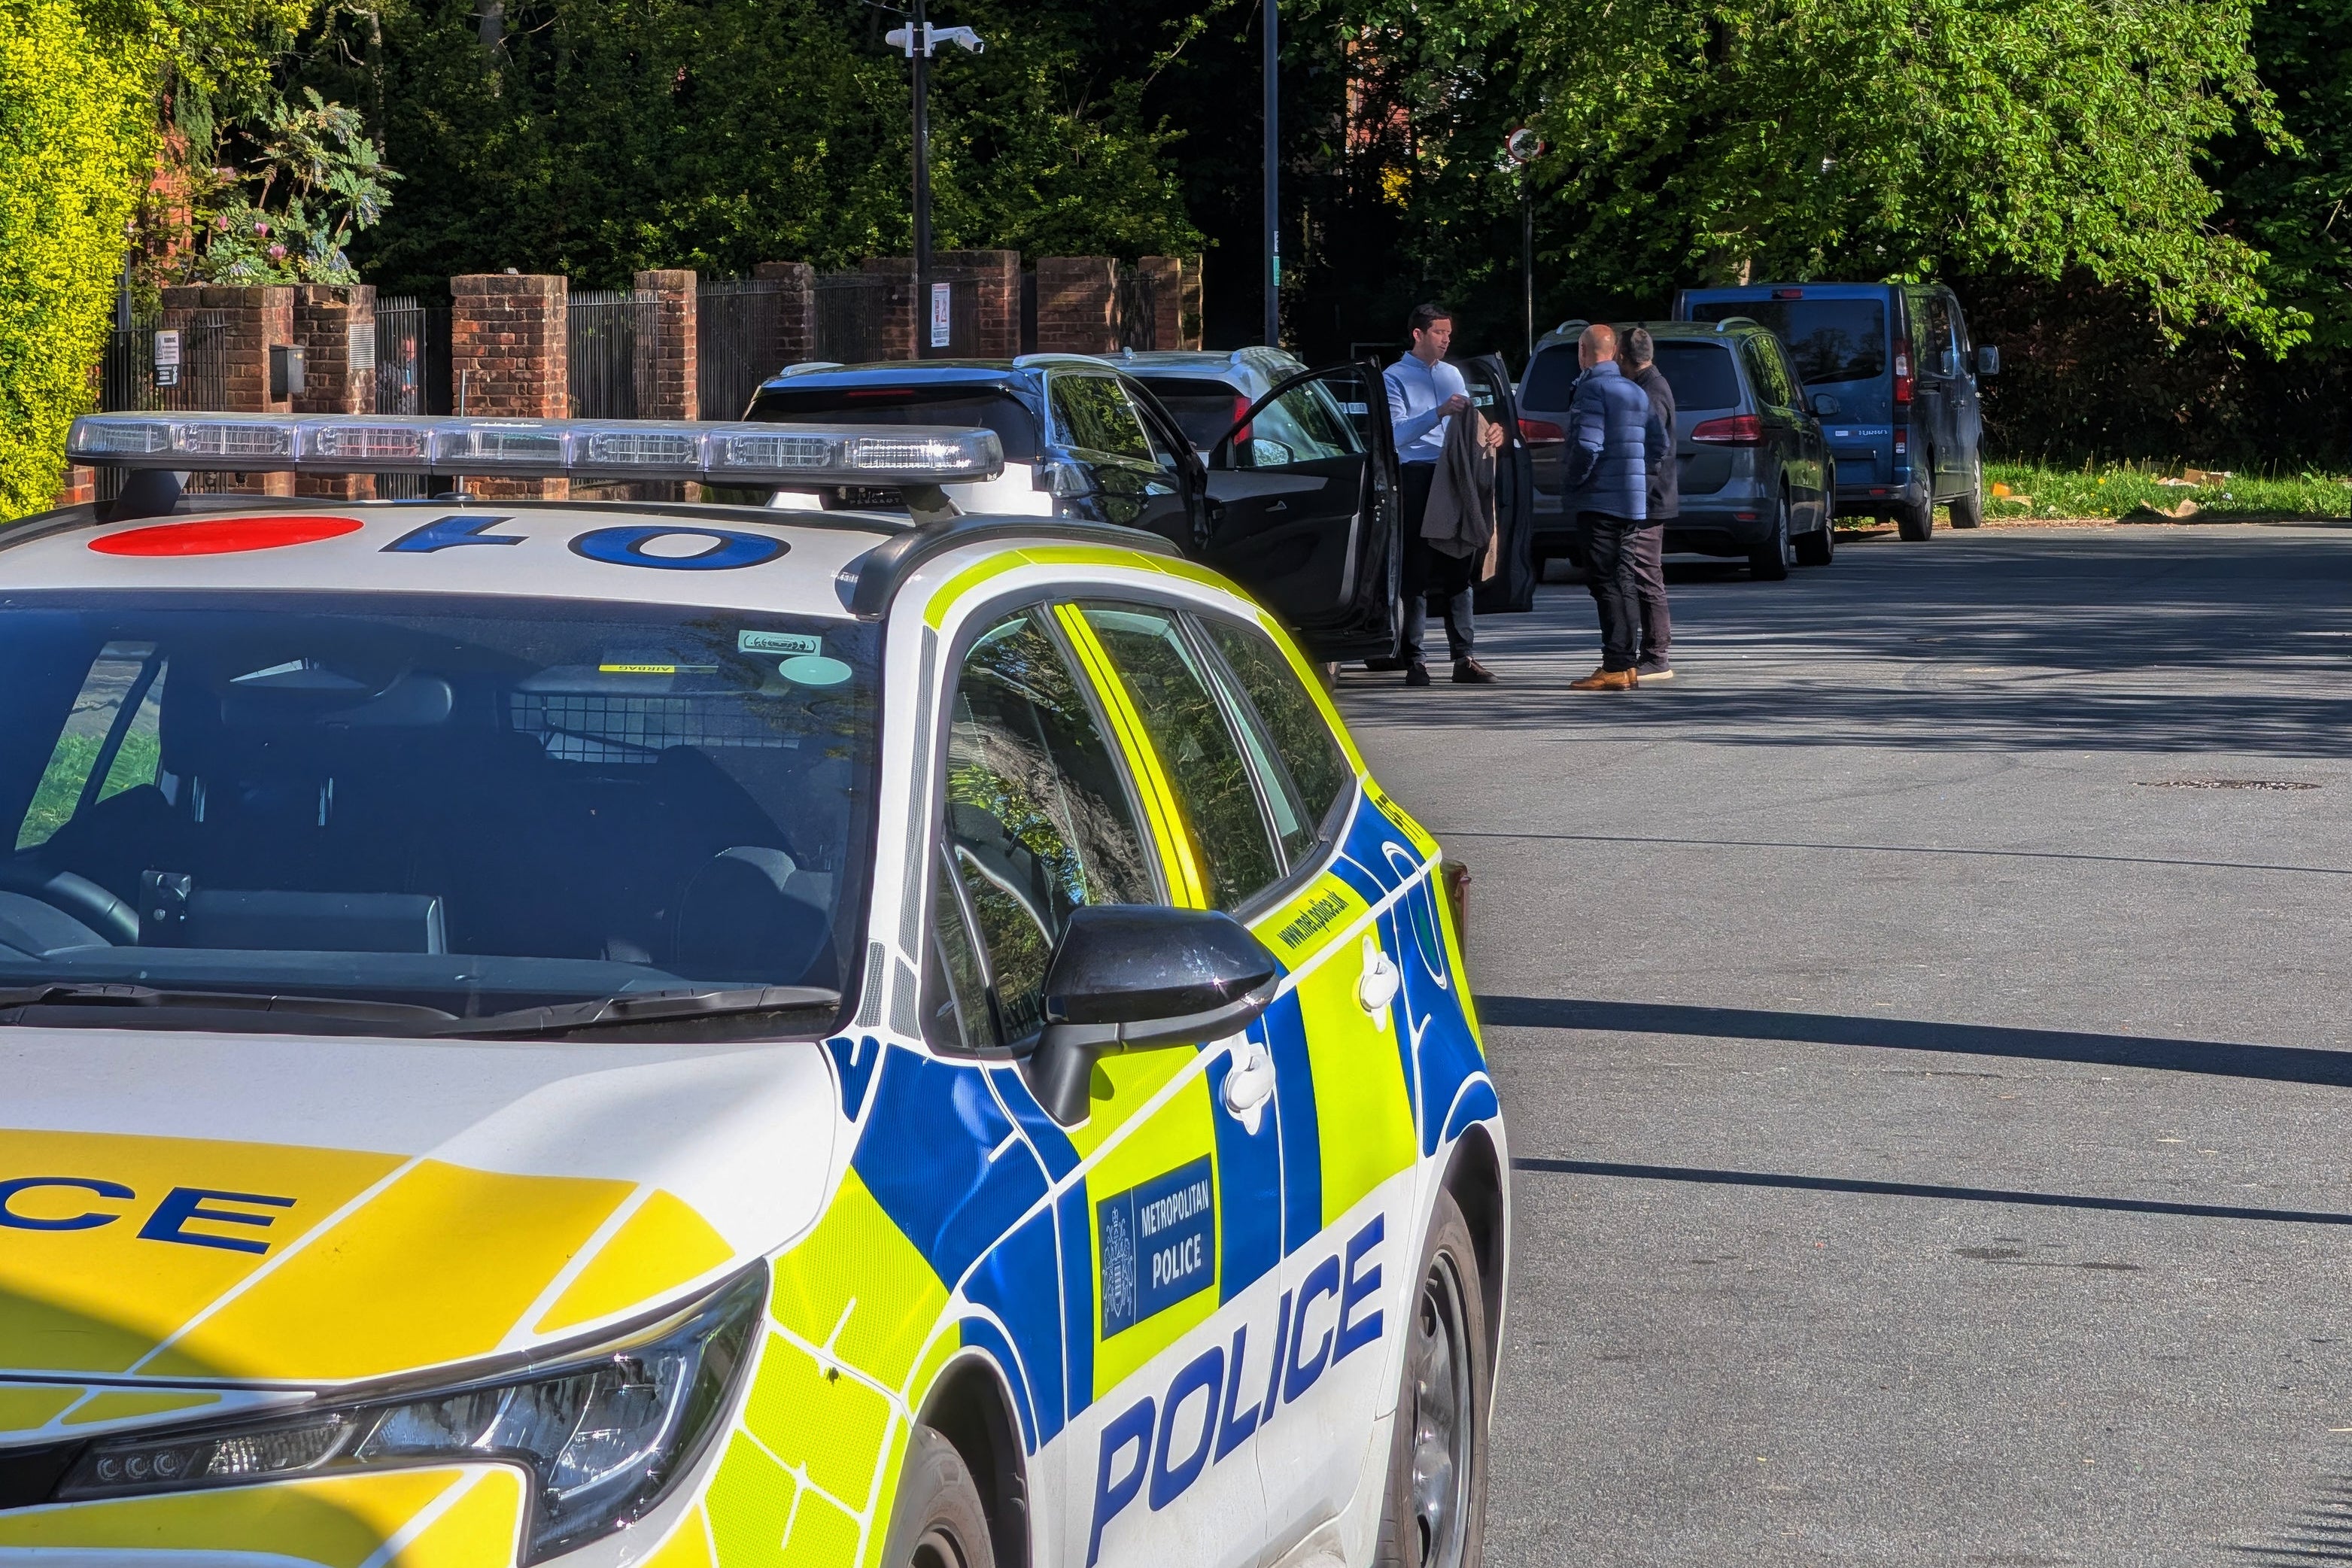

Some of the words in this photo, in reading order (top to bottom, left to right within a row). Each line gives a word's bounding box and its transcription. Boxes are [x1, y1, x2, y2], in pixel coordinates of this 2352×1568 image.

[1277, 888, 1349, 950] www.met.police.uk
[0, 1177, 297, 1254] CE
[1141, 1179, 1209, 1238] METROPOLITAN
[1152, 1233, 1202, 1289] POLICE
[1086, 1212, 1384, 1568] POLICE
